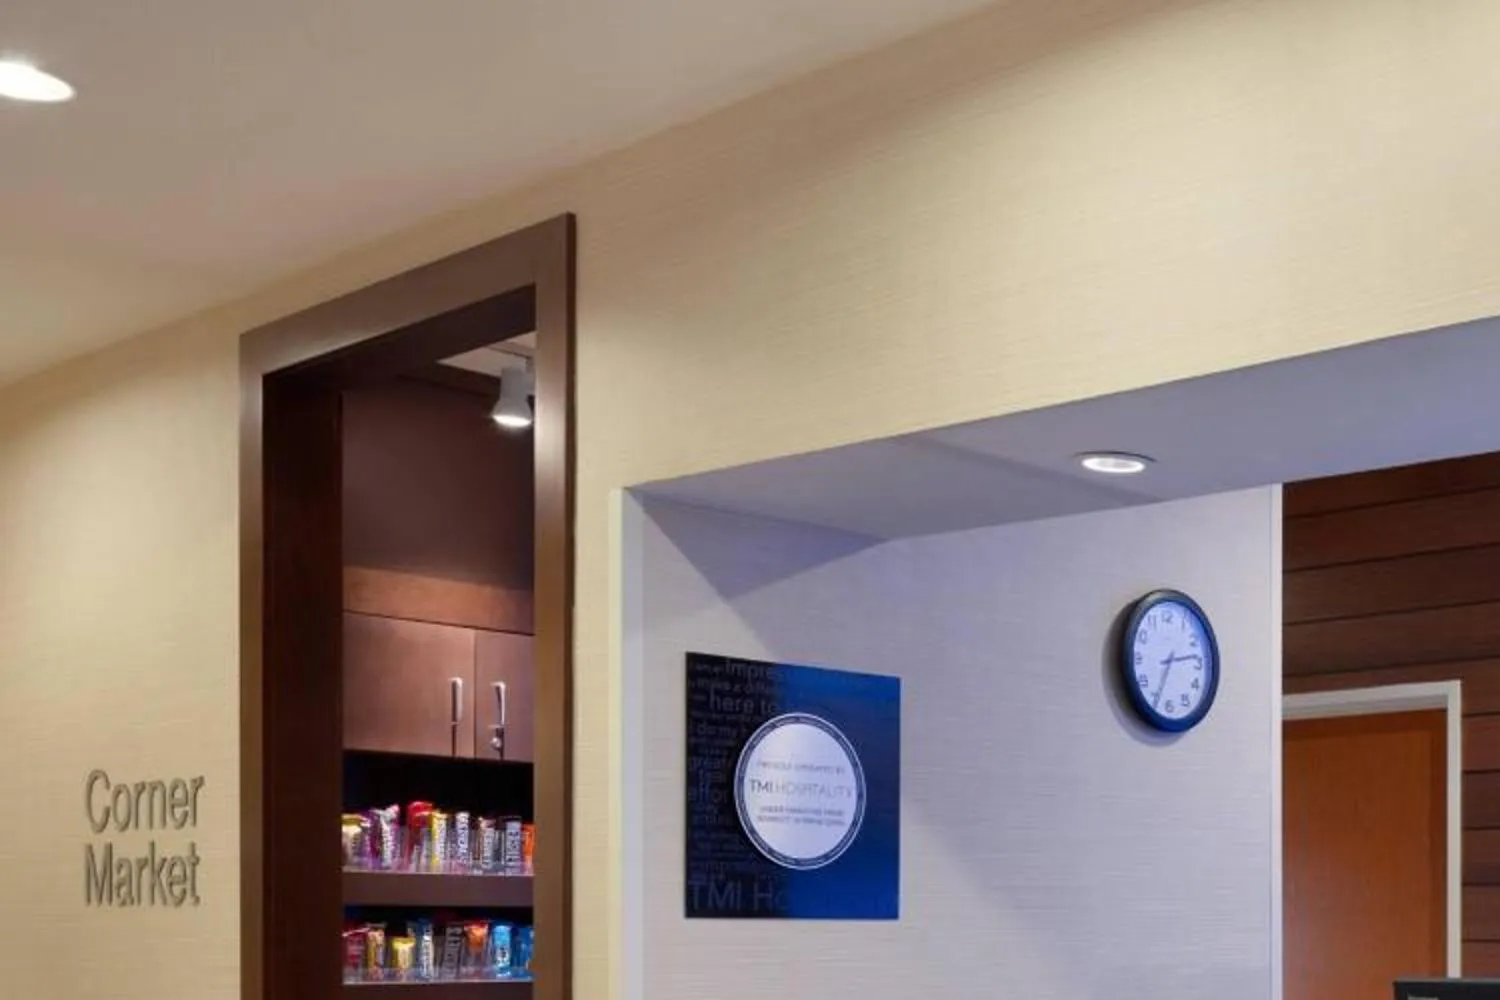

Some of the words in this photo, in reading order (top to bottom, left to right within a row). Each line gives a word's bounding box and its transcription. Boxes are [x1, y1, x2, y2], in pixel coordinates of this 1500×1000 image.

[1190, 678, 1199, 691] 4
[1164, 700, 1174, 713] 6
[749, 778, 774, 794] TMI
[85, 769, 205, 834] Corner
[84, 841, 201, 907] Market
[688, 880, 742, 912] TMI
